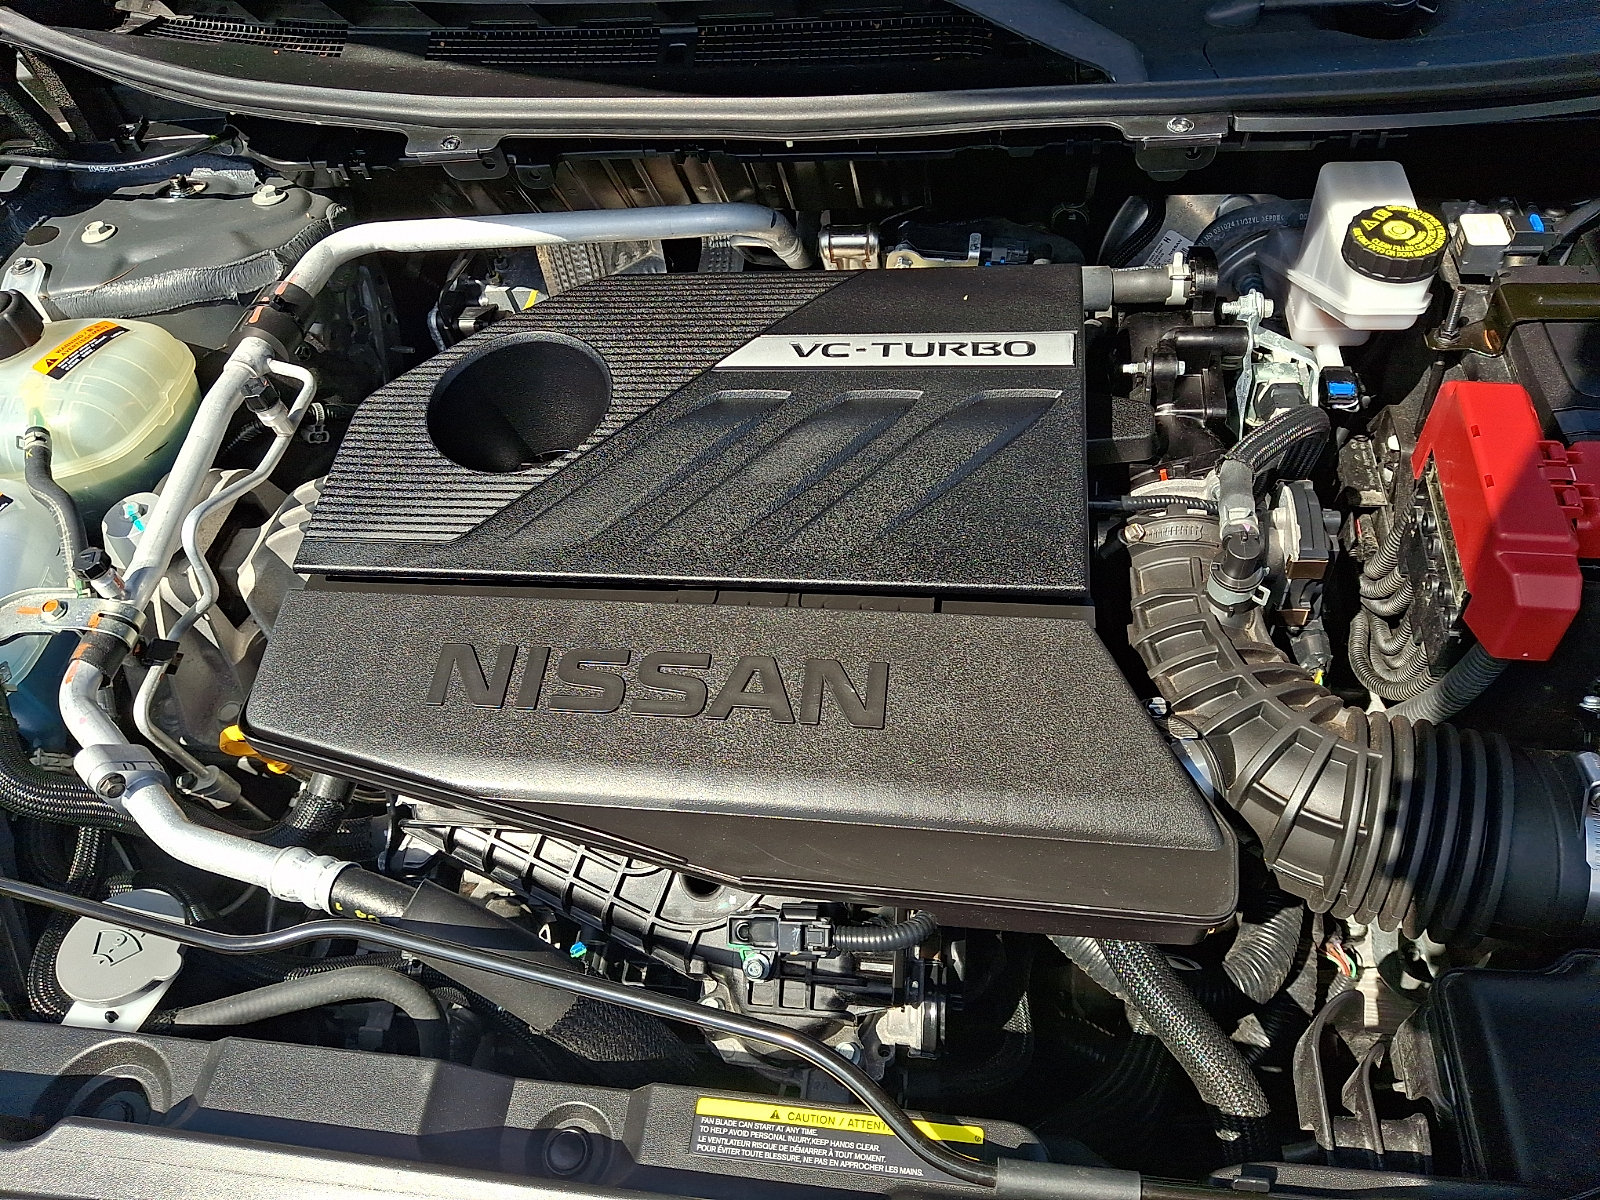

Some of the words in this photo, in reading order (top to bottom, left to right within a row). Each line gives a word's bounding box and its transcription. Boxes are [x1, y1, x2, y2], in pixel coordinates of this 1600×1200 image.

[789, 340, 1037, 358] VC-TURBO
[425, 642, 890, 730] NISSAN
[700, 1116, 715, 1125] FAN
[715, 1118, 738, 1127] BLADE
[739, 1120, 753, 1129] CAN
[754, 1122, 775, 1131] START
[801, 1128, 818, 1136] TIME.
[788, 1112, 836, 1125] CAUTION
[707, 1136, 751, 1148] VENTILATEUR
[752, 1141, 778, 1151] RISQUE
[790, 1144, 827, 1157] DÉMARRER
[834, 1150, 853, 1159] TOUT
[854, 1152, 886, 1163] MOMENT.
[728, 1128, 749, 1138] AVOID
[750, 1131, 786, 1141] PERSONAL
[830, 1140, 855, 1149] HANDS
[856, 1143, 880, 1152] CLEAR.
[697, 1144, 716, 1153] POUR
[718, 1144, 740, 1156] ÉVITER
[741, 1149, 764, 1158] TOUTE
[764, 1151, 802, 1163] BLESSURE,
[840, 1161, 884, 1171] APPROCHER
[900, 1167, 924, 1176] MAINS.
